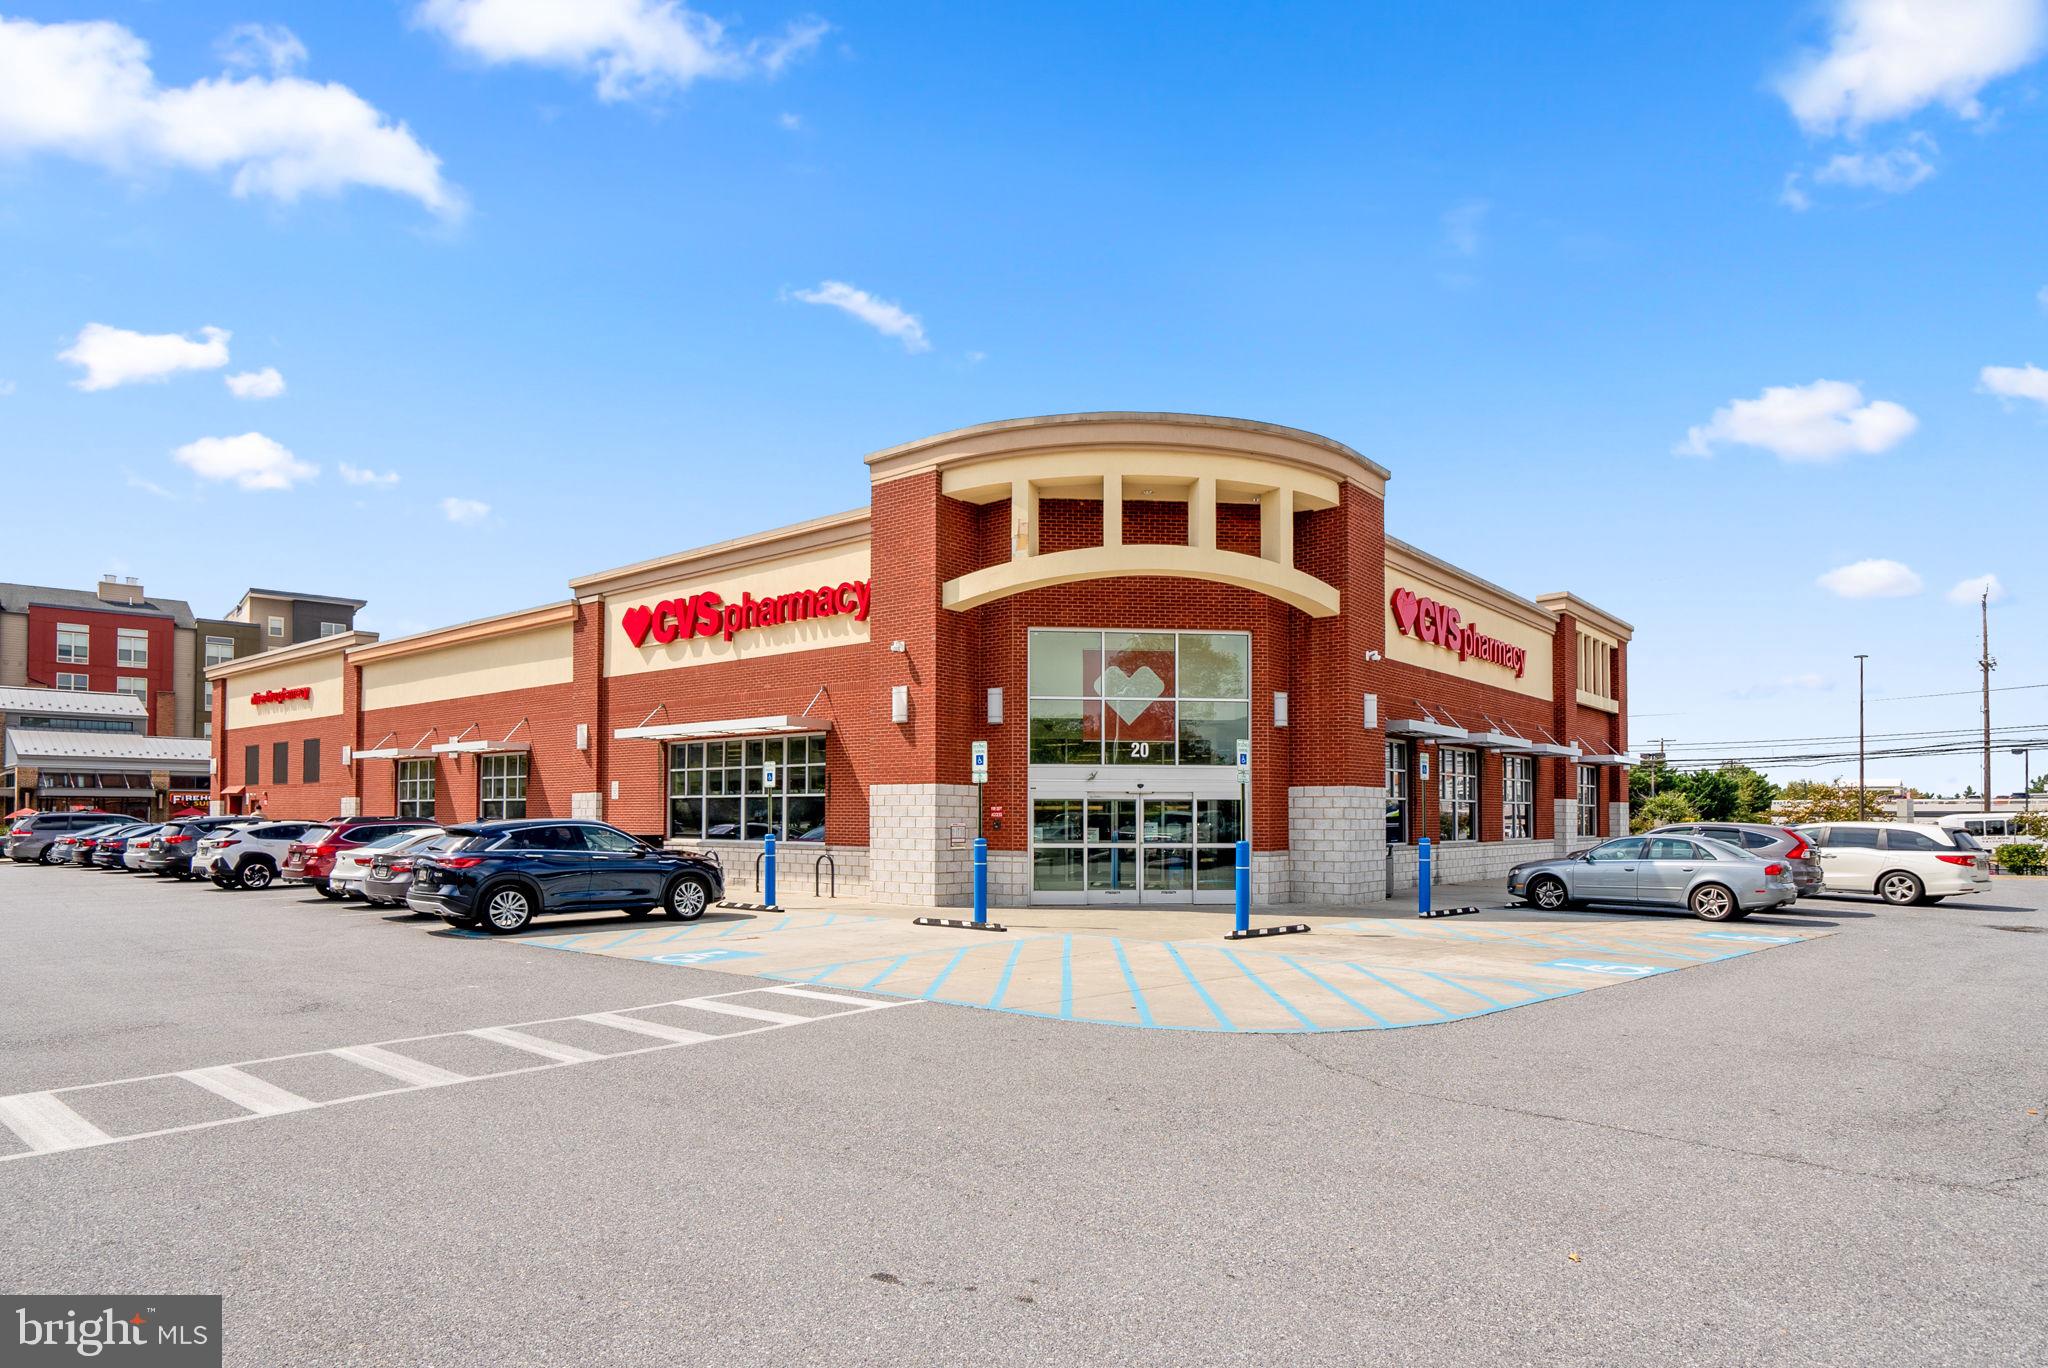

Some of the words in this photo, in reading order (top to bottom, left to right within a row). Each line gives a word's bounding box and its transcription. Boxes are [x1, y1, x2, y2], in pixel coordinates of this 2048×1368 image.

[651, 590, 724, 645] CVS
[723, 577, 871, 642] pharmacy
[1414, 596, 1462, 652] CVS
[1458, 622, 1527, 679] pharmacy
[1130, 742, 1149, 758] 20
